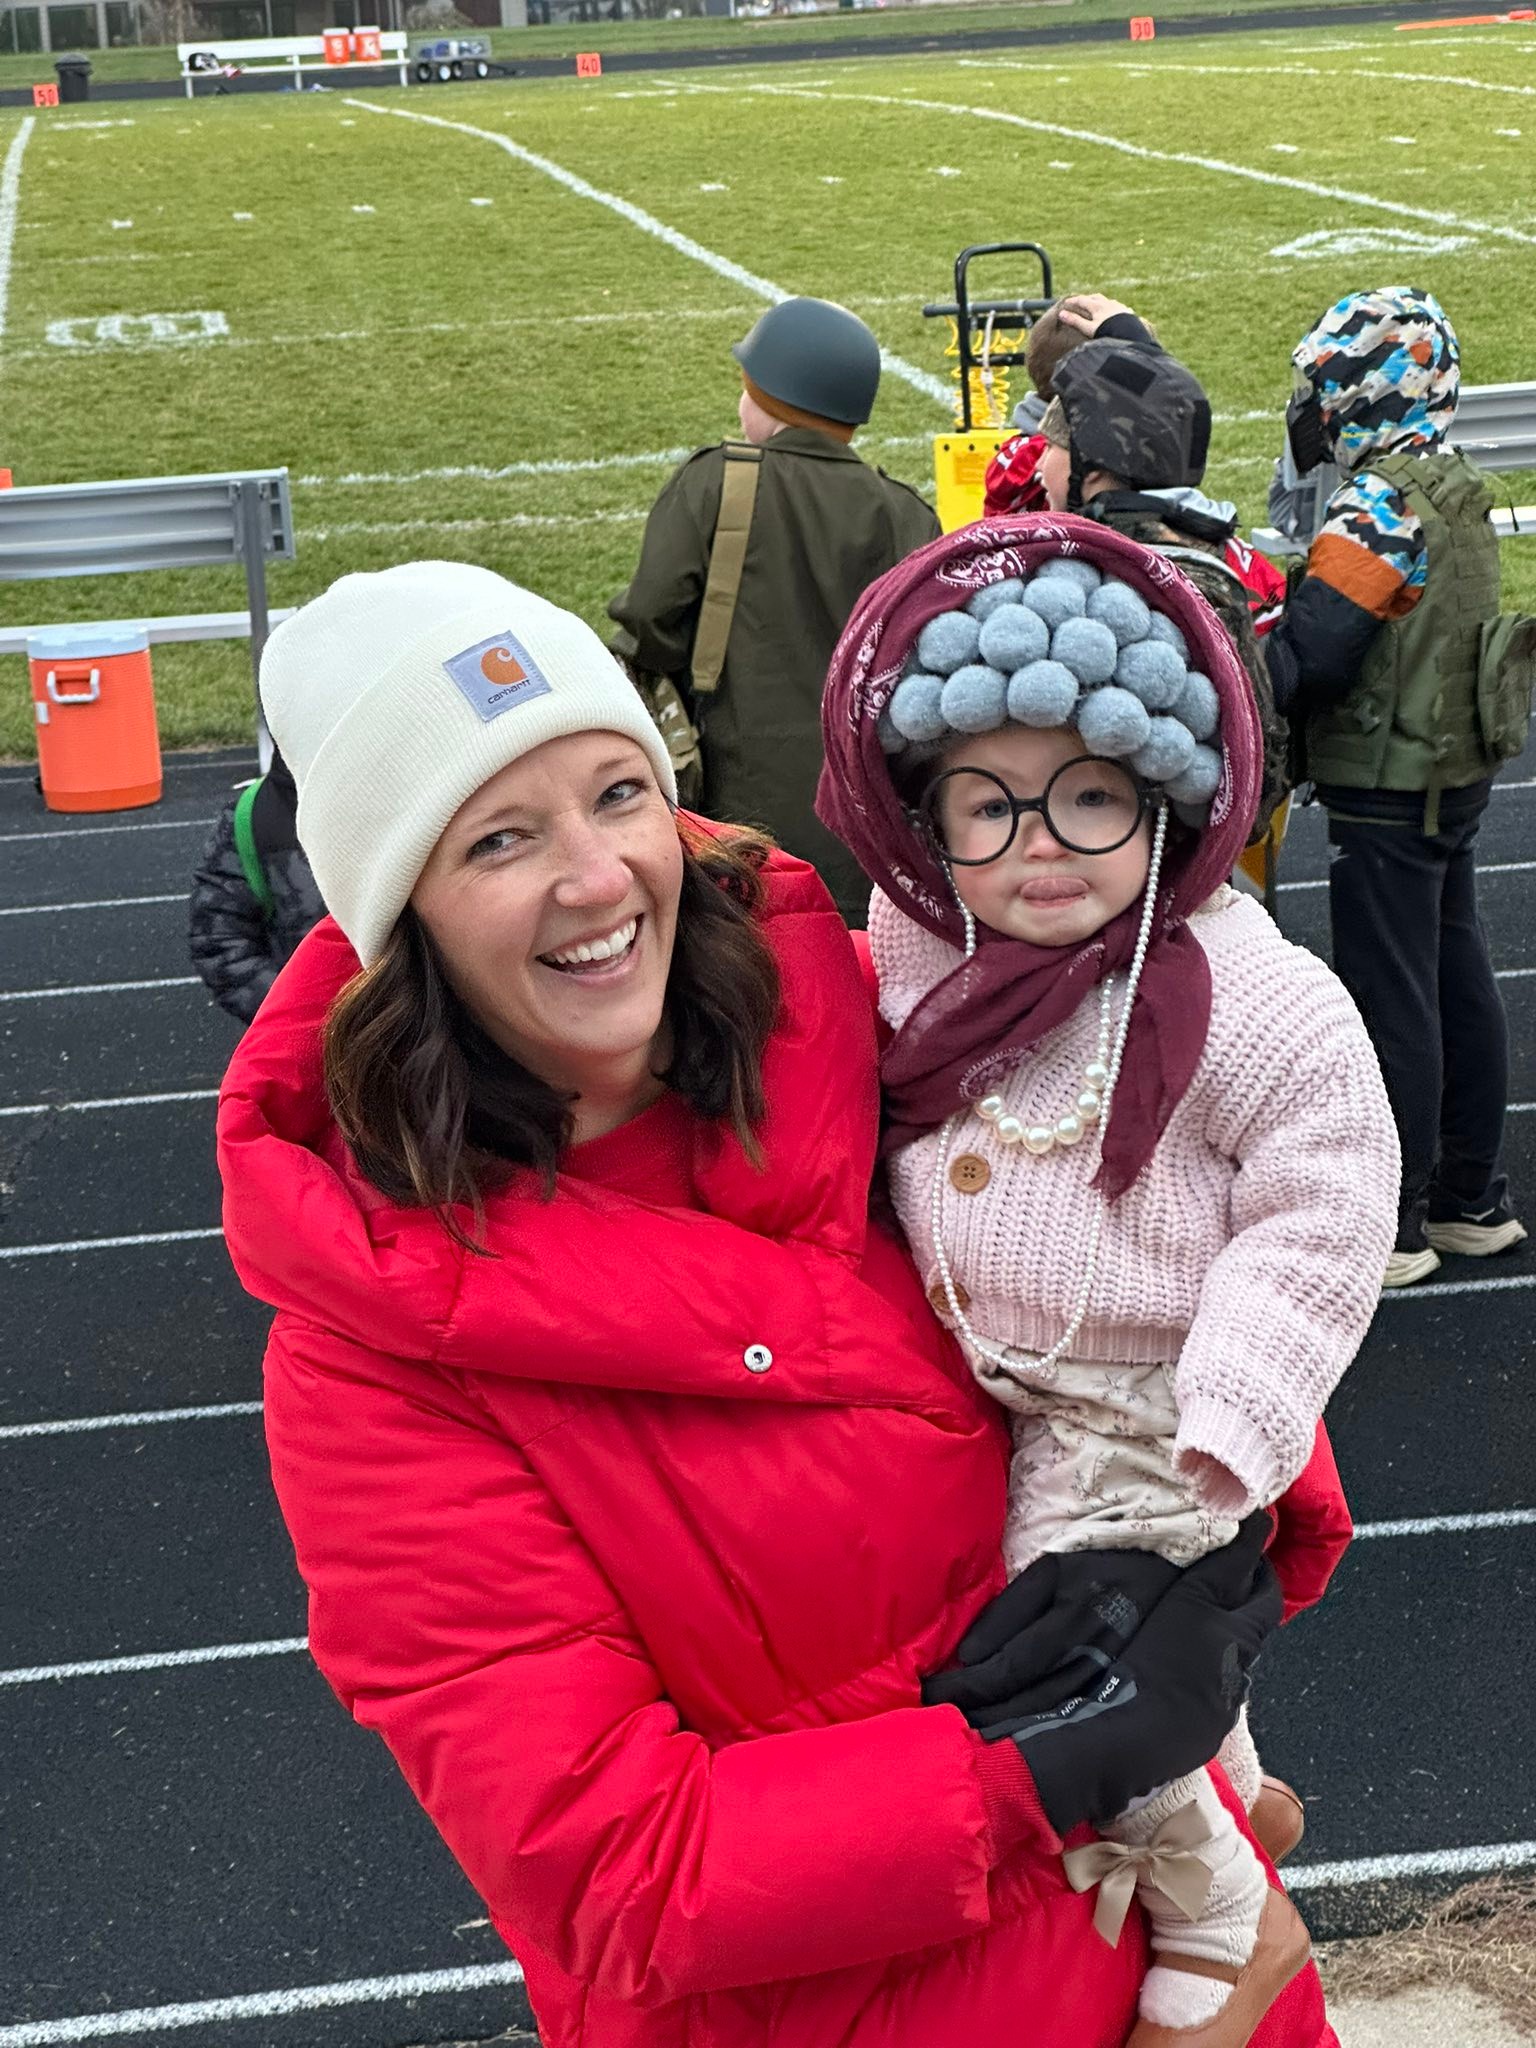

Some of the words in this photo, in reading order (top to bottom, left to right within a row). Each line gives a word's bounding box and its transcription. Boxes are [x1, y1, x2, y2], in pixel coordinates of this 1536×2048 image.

[581, 57, 598, 74] 40
[37, 88, 55, 106] 50
[487, 679, 531, 704] carhartt
